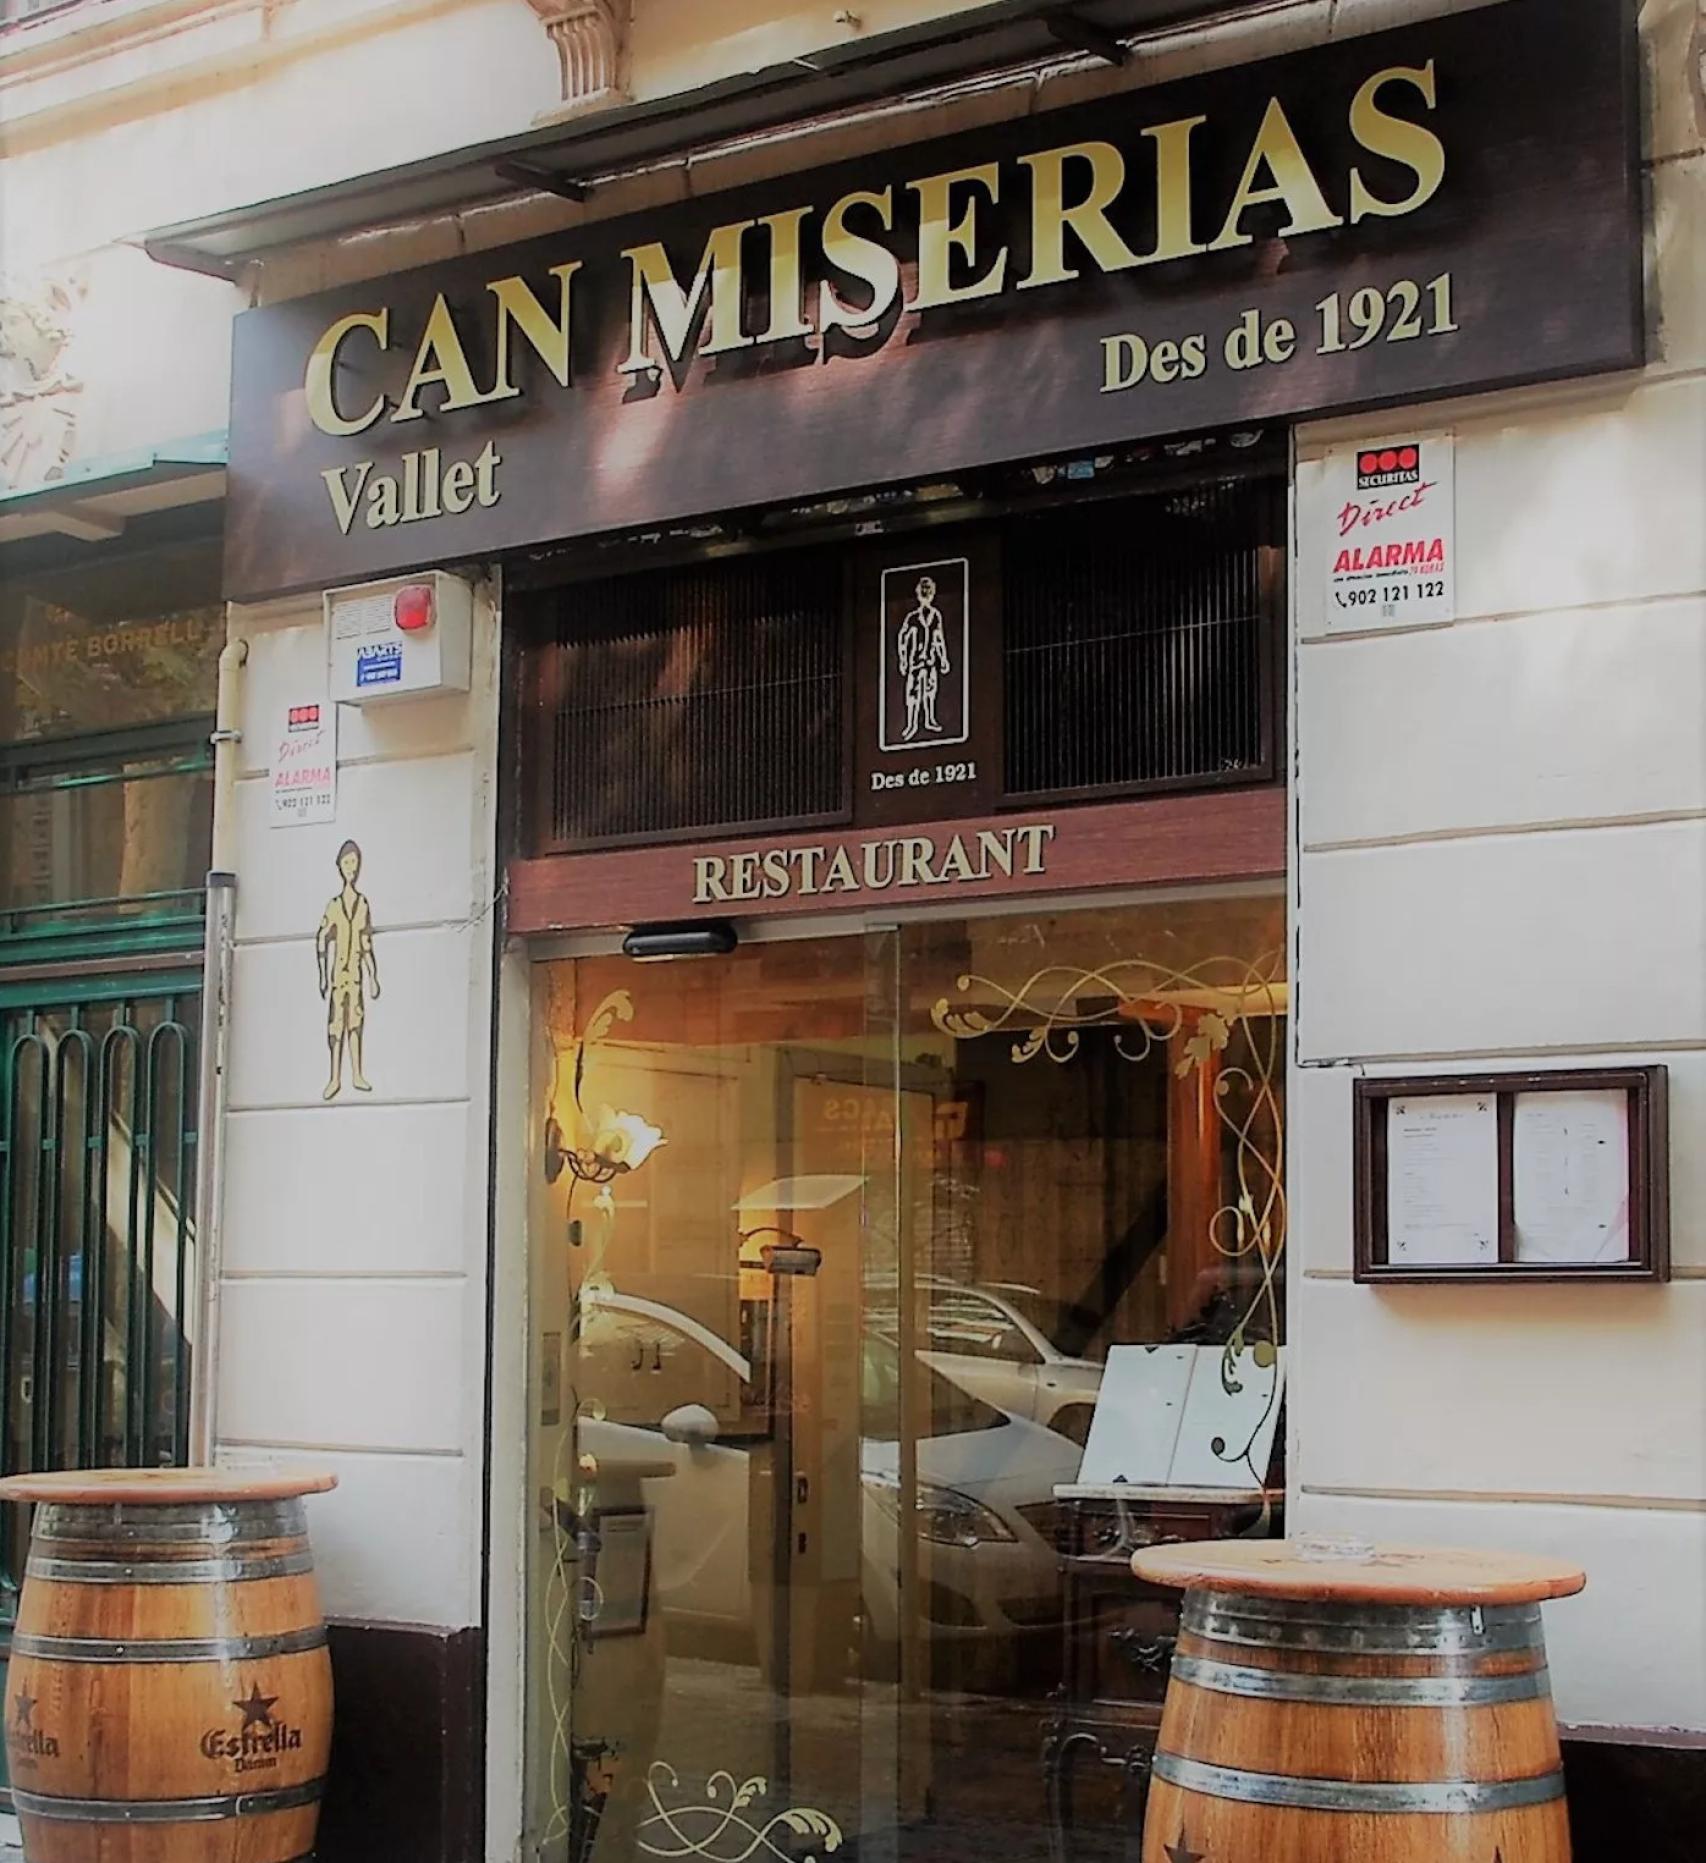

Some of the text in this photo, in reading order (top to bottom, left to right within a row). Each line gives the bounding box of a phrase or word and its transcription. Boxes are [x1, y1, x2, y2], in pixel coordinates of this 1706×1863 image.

[305, 59, 1445, 436] CAN MISERIAS
[1101, 272, 1458, 393] Des de 1921
[320, 440, 501, 535] Vallet
[1337, 481, 1438, 536] Direct
[1333, 538, 1443, 573] ALARMA
[1348, 580, 1443, 606] 902 121 122
[871, 762, 976, 790] Des de 1921
[692, 824, 1054, 904] RESTAURANT
[201, 1721, 301, 1759] Estrella
